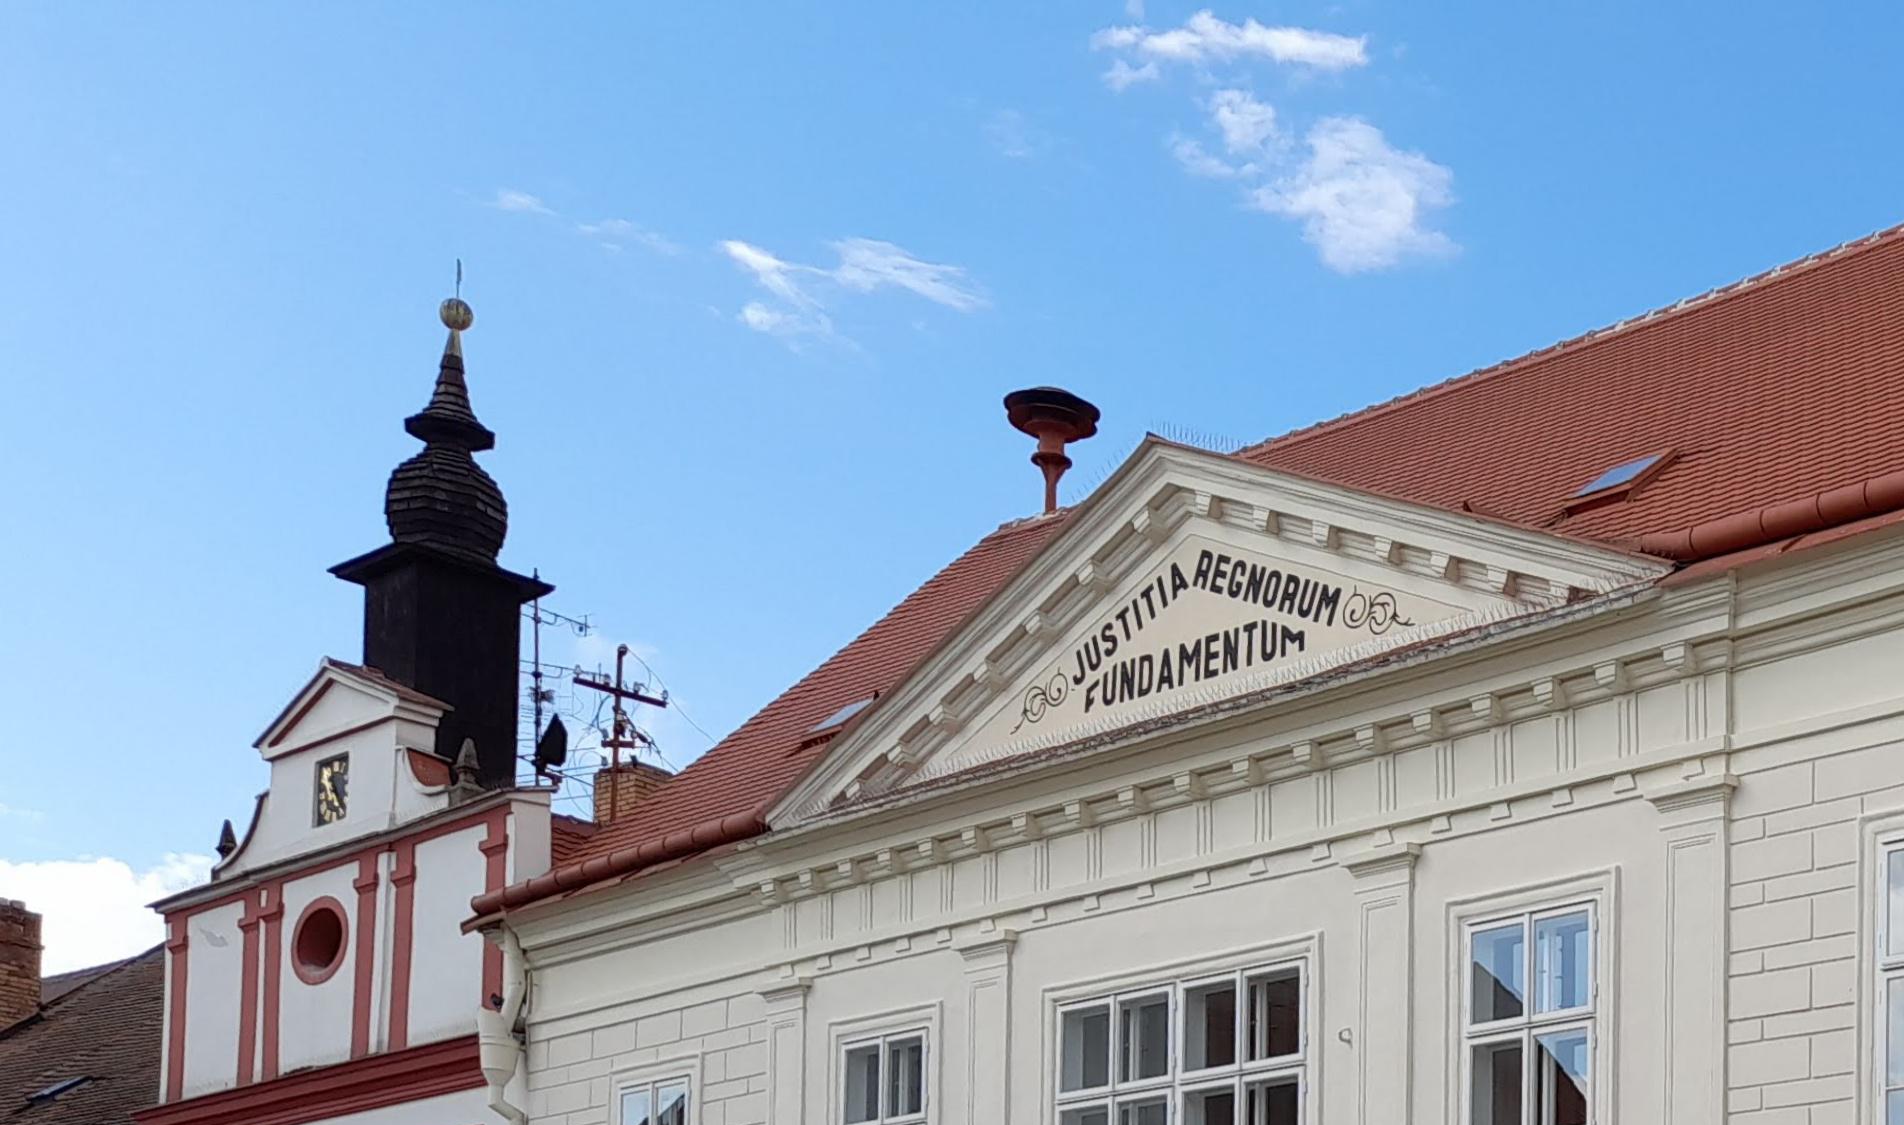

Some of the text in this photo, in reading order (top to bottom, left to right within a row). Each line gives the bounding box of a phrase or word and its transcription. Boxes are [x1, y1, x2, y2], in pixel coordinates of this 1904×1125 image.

[1072, 549, 1342, 685] JUSTITIA REGNORUM
[1084, 619, 1305, 713] FUNDAMENTUM
